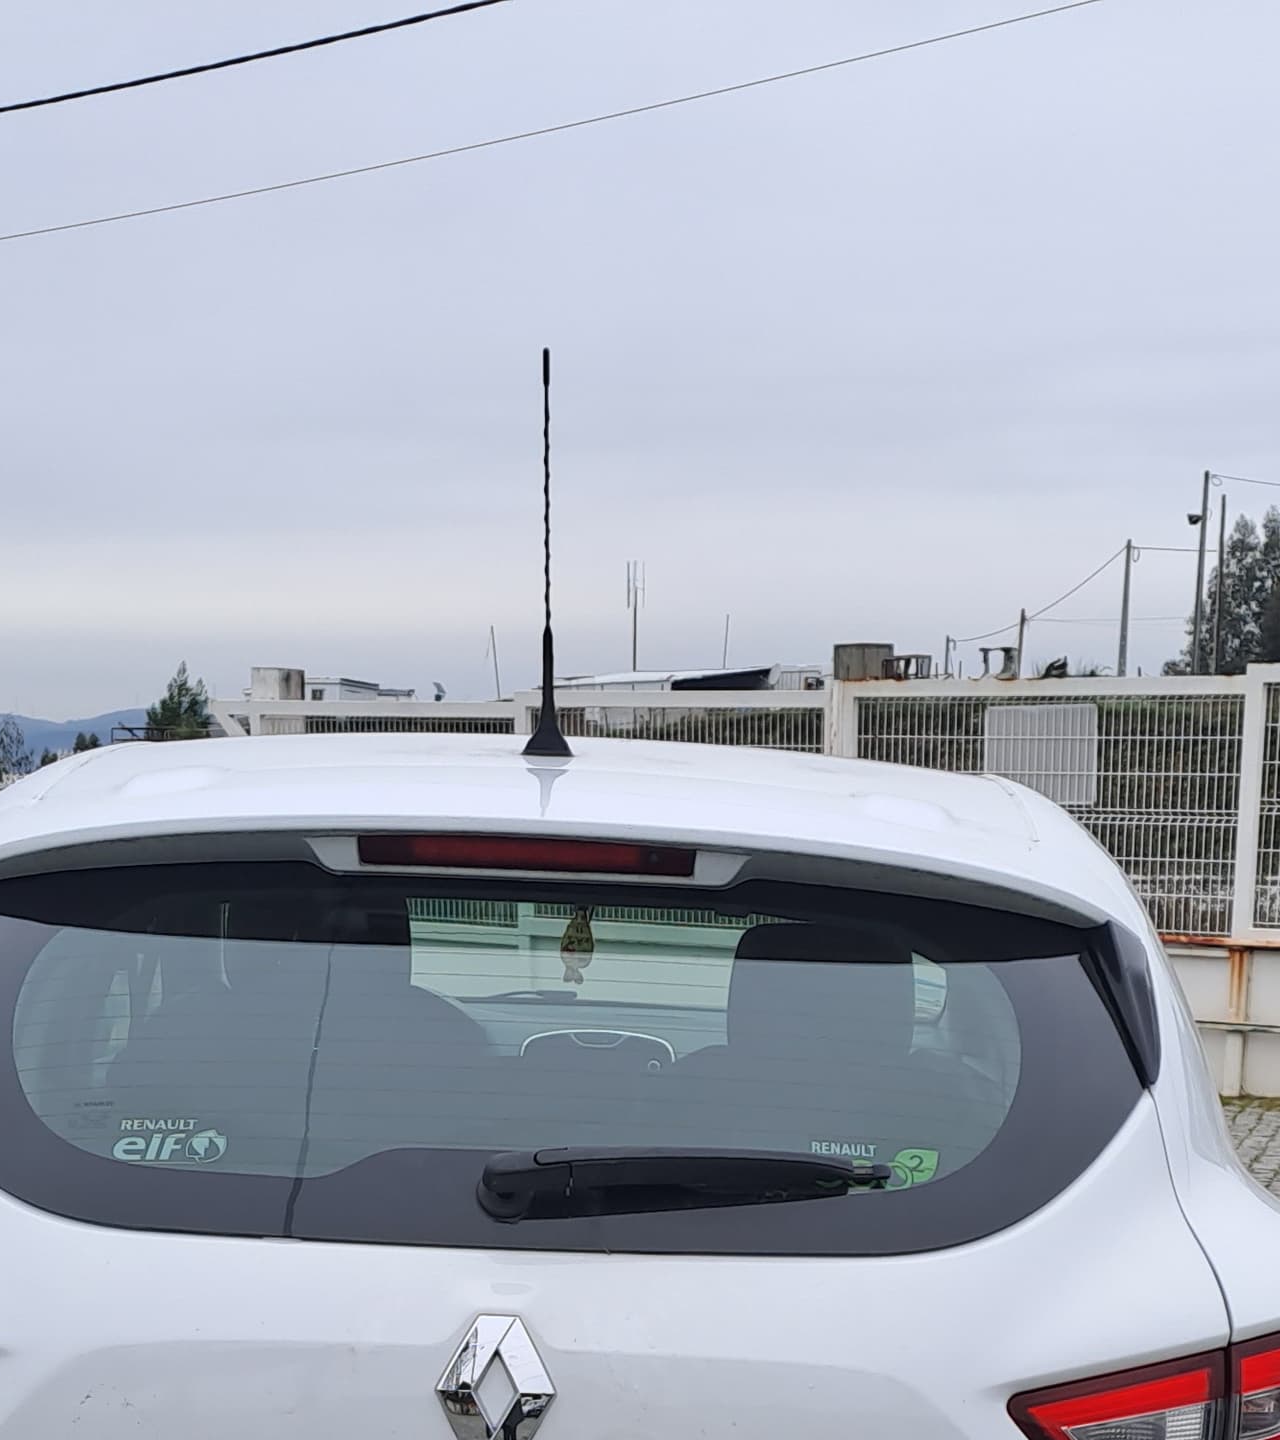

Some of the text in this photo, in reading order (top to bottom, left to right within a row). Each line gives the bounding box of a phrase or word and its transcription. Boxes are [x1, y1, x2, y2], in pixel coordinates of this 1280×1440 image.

[120, 1119, 198, 1130] RENAULT
[112, 1133, 186, 1161] elf
[811, 1141, 877, 1157] RENAULT
